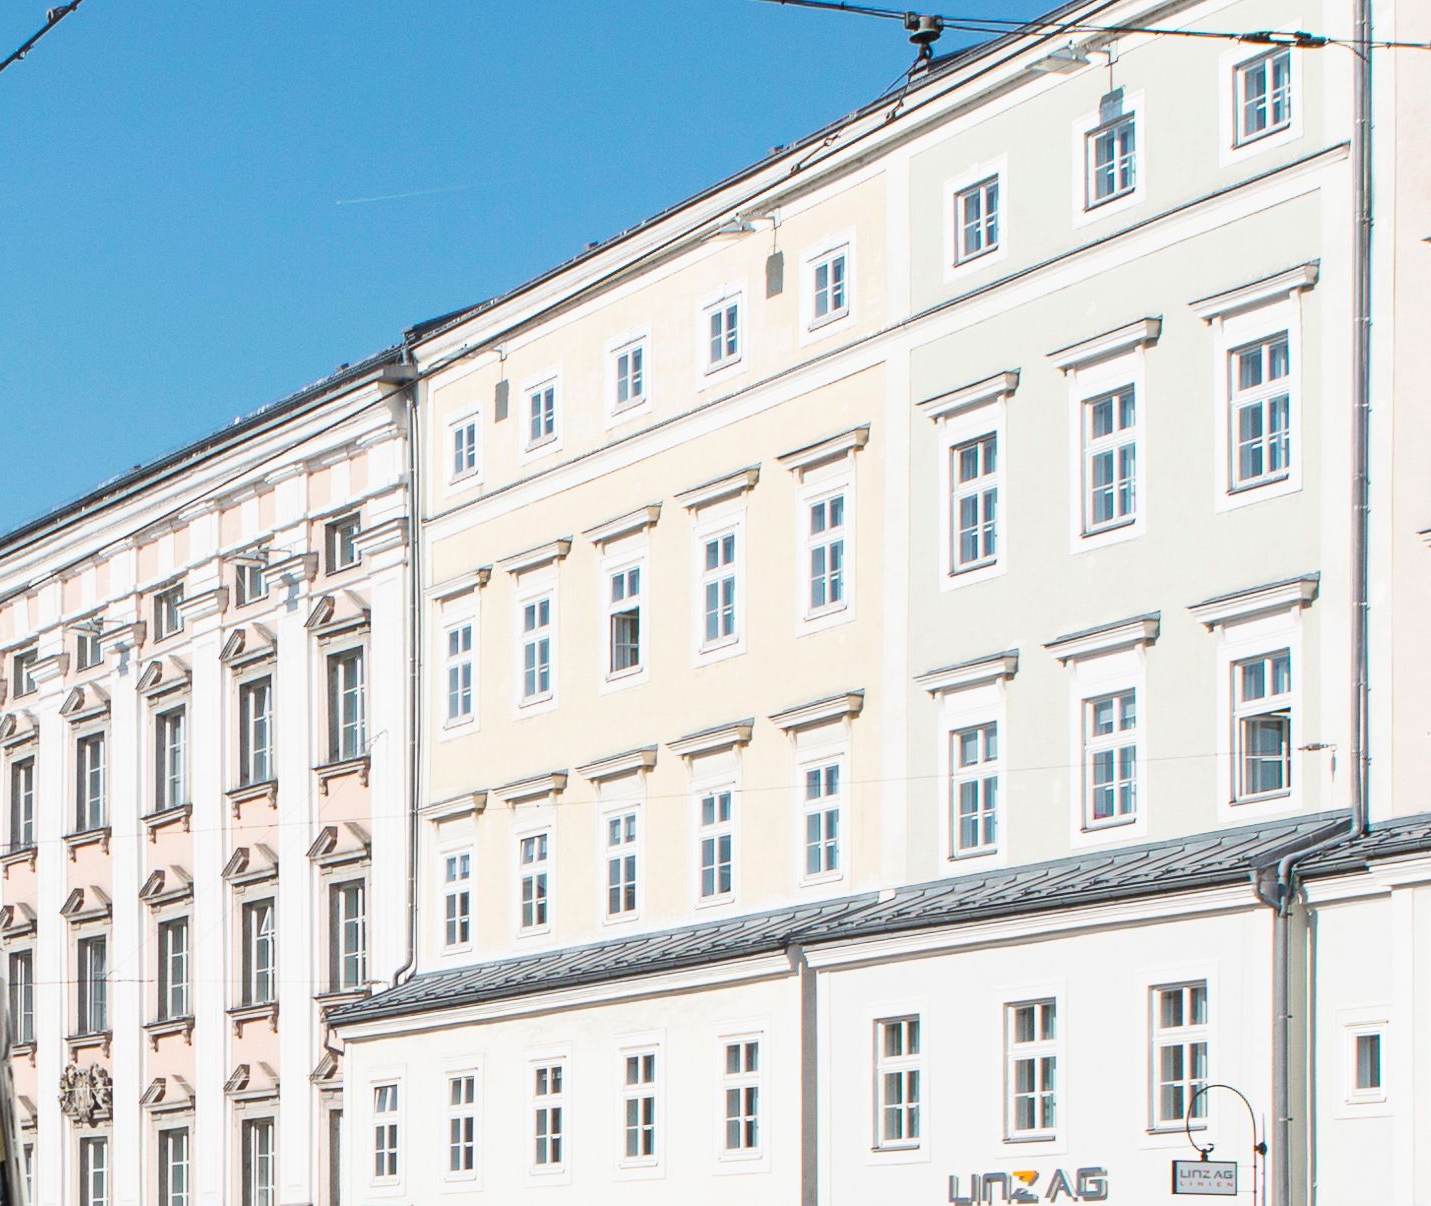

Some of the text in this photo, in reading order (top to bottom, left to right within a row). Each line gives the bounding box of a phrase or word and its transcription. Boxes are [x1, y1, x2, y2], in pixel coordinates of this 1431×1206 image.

[1180, 1169, 1233, 1179] LINZ AG
[948, 1167, 1108, 1206] LINZ AG
